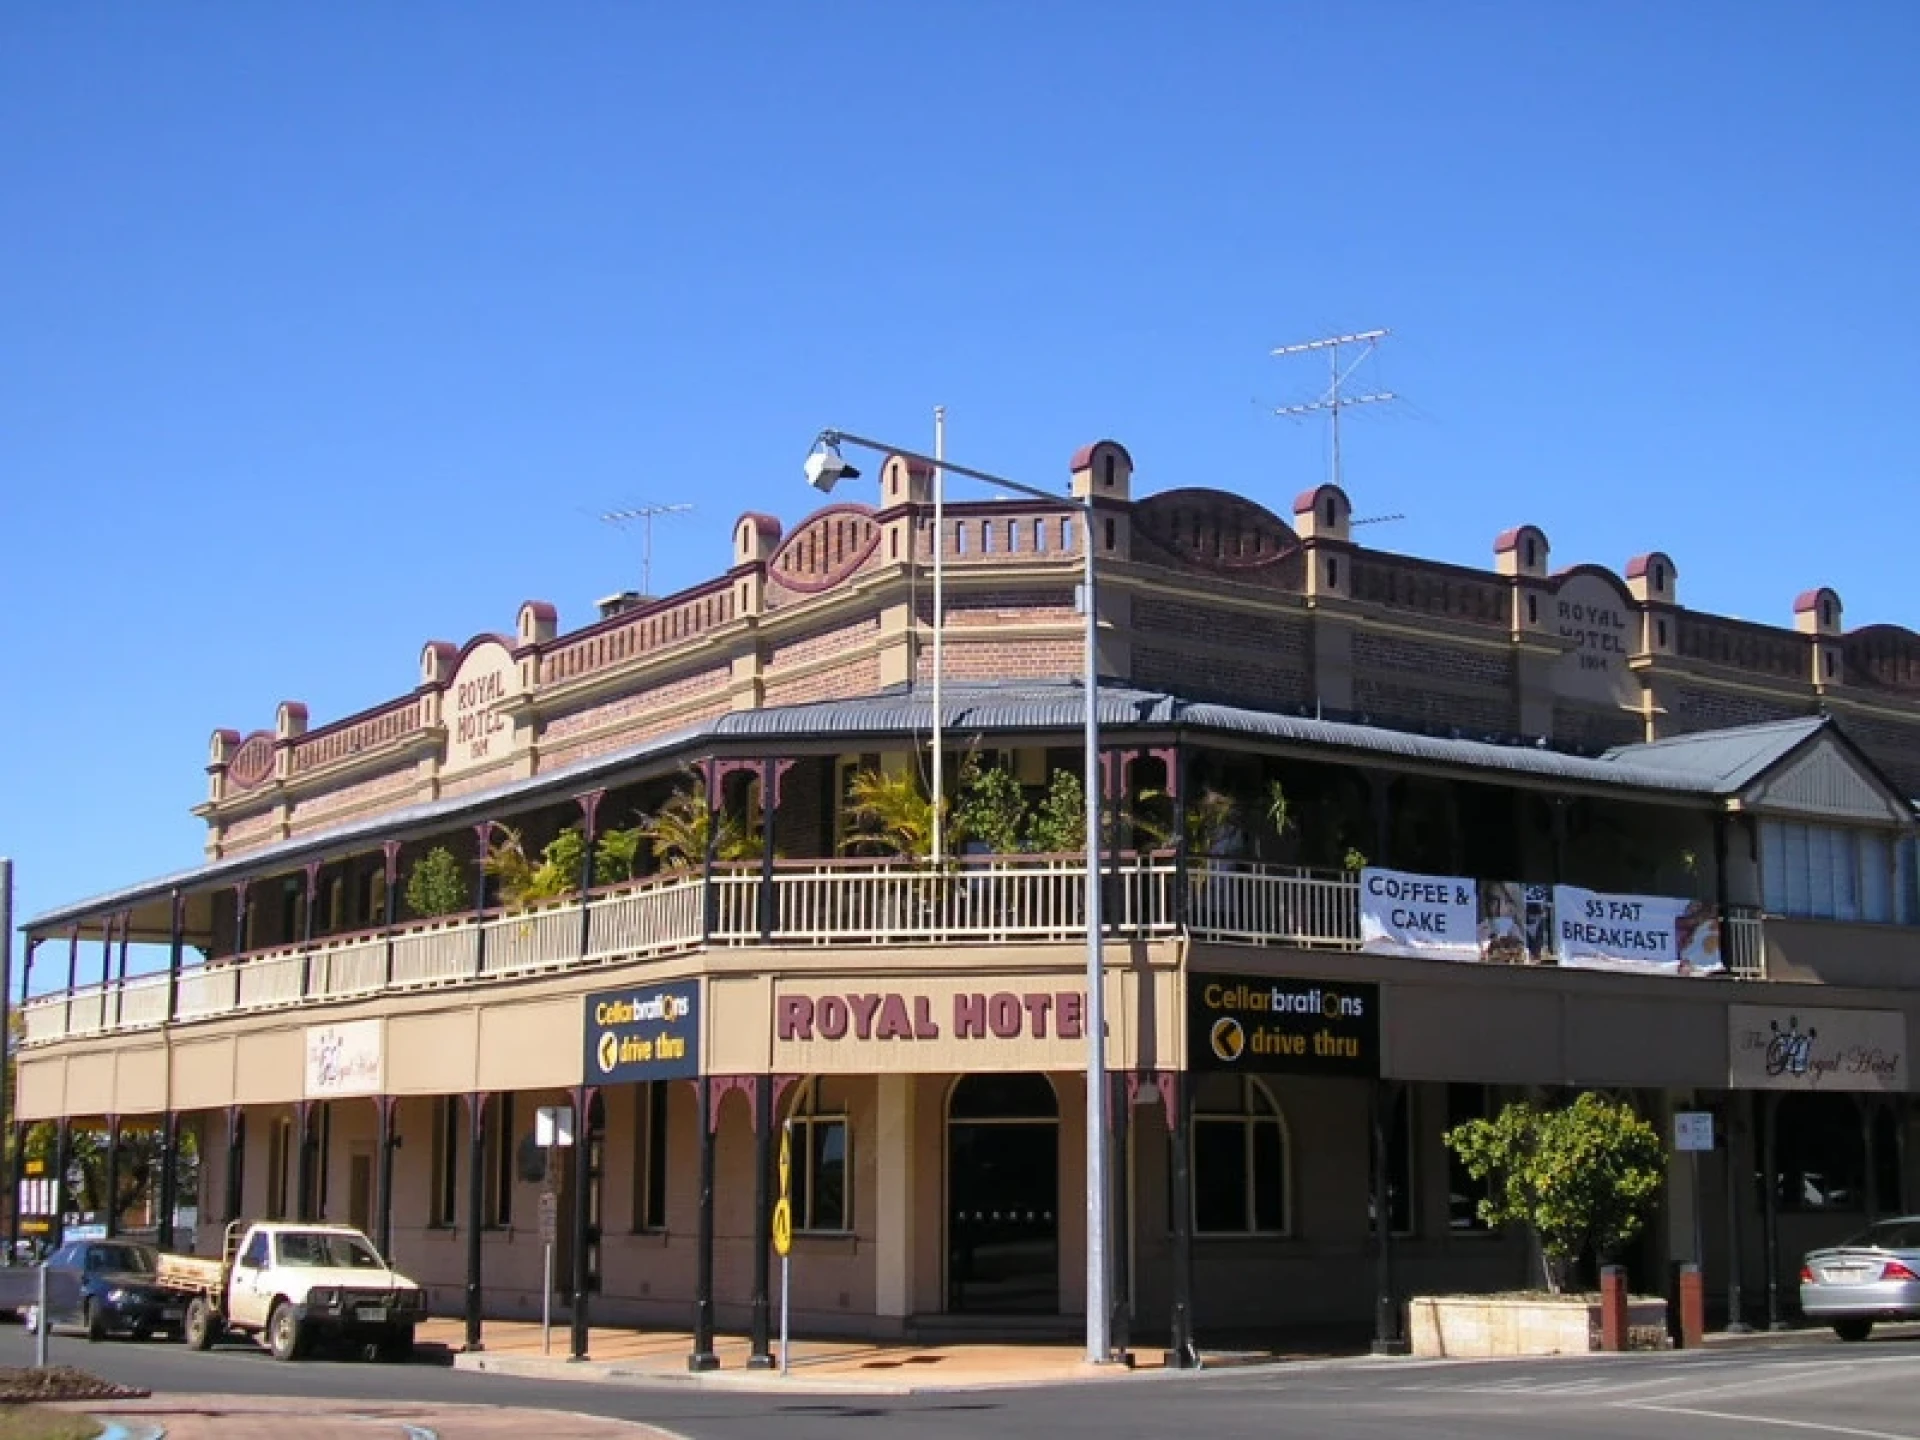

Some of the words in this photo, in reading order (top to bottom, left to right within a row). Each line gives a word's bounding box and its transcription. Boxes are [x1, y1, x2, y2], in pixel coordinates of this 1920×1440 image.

[1559, 601, 1624, 629] ROYAL
[458, 670, 505, 711] ROYAL
[457, 709, 505, 744] HOTEL
[1367, 875, 1448, 904] COFFEE
[1456, 885, 1470, 906] &
[1391, 908, 1446, 933] CAKE
[1607, 901, 1644, 921] FAT
[1562, 920, 1669, 950] BREAKFAST
[778, 993, 939, 1040] ROYAL
[619, 1035, 652, 1063] drive
[655, 1031, 685, 1059] thru
[1251, 1025, 1306, 1055] drive
[1313, 1029, 1359, 1057] thru
